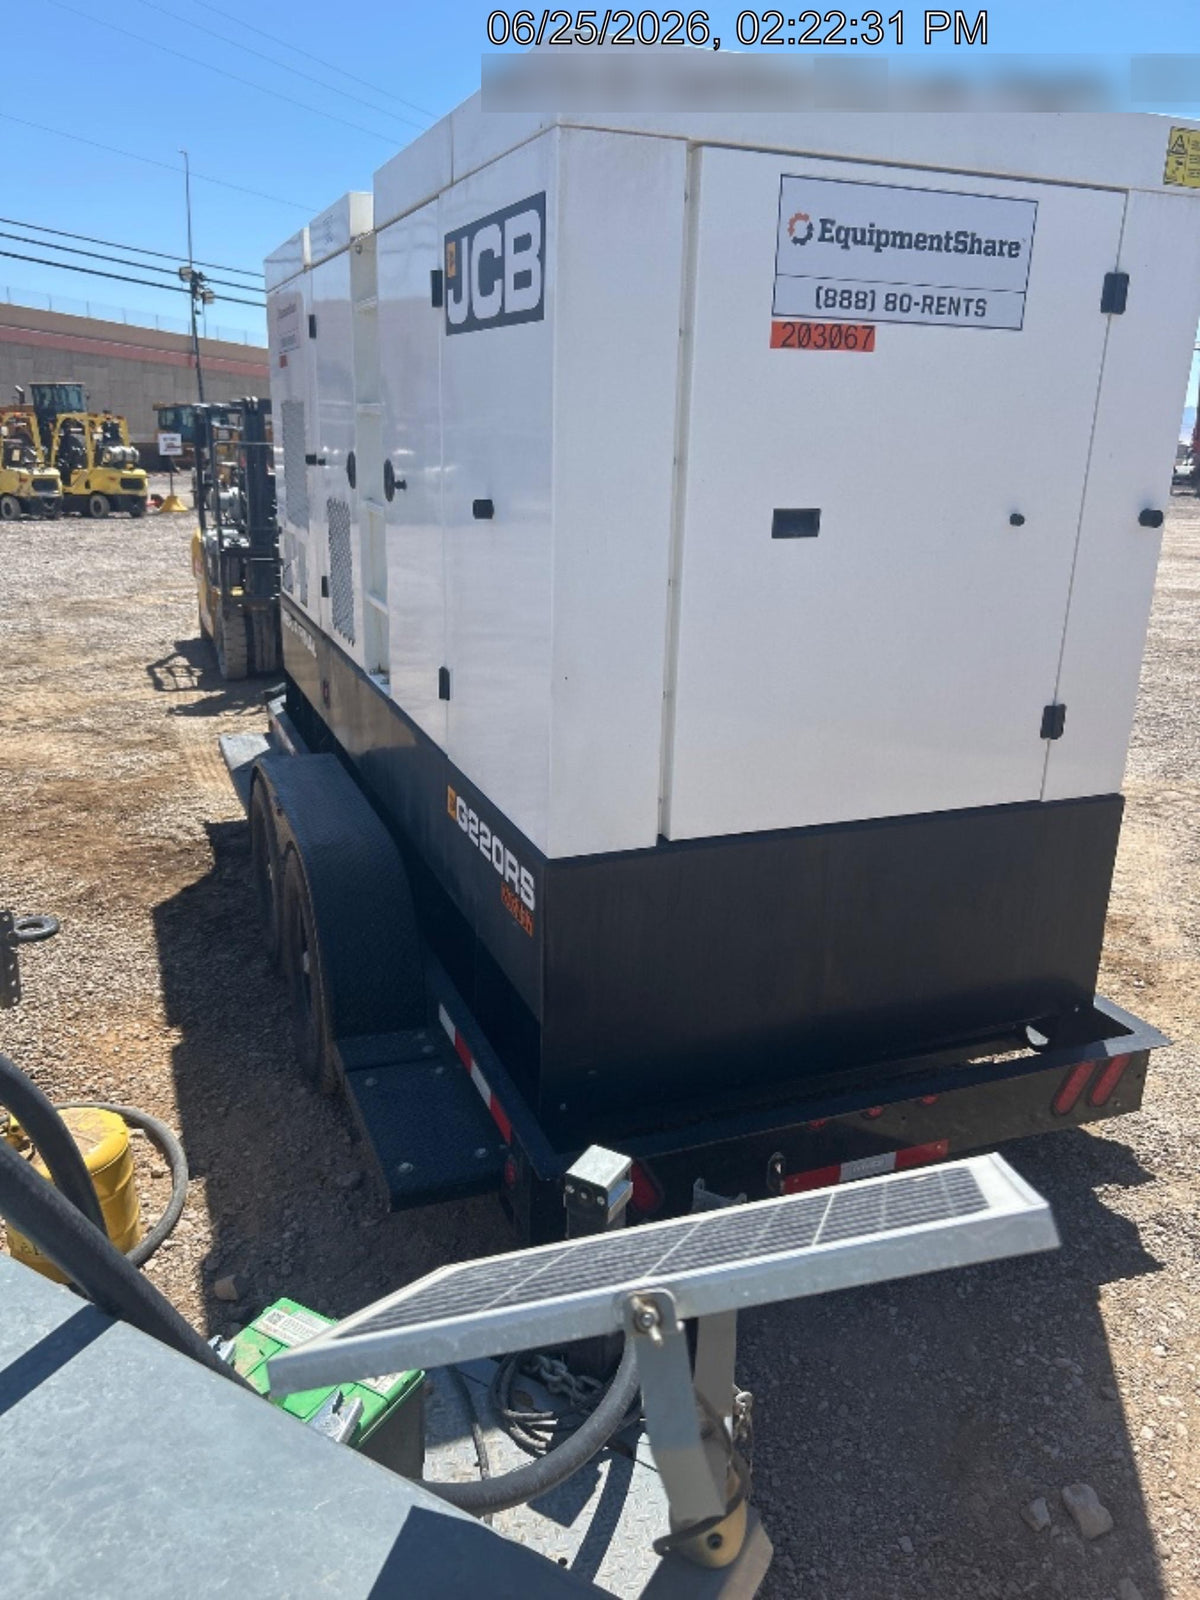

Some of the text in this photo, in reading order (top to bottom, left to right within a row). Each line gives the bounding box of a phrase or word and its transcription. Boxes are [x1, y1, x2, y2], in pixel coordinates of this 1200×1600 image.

[817, 217, 1021, 259] EquipmentShare
[447, 208, 542, 325] JCB
[815, 285, 988, 318] (888) 80-RENTS
[780, 322, 875, 350] 203067
[456, 795, 536, 911] G220RS
